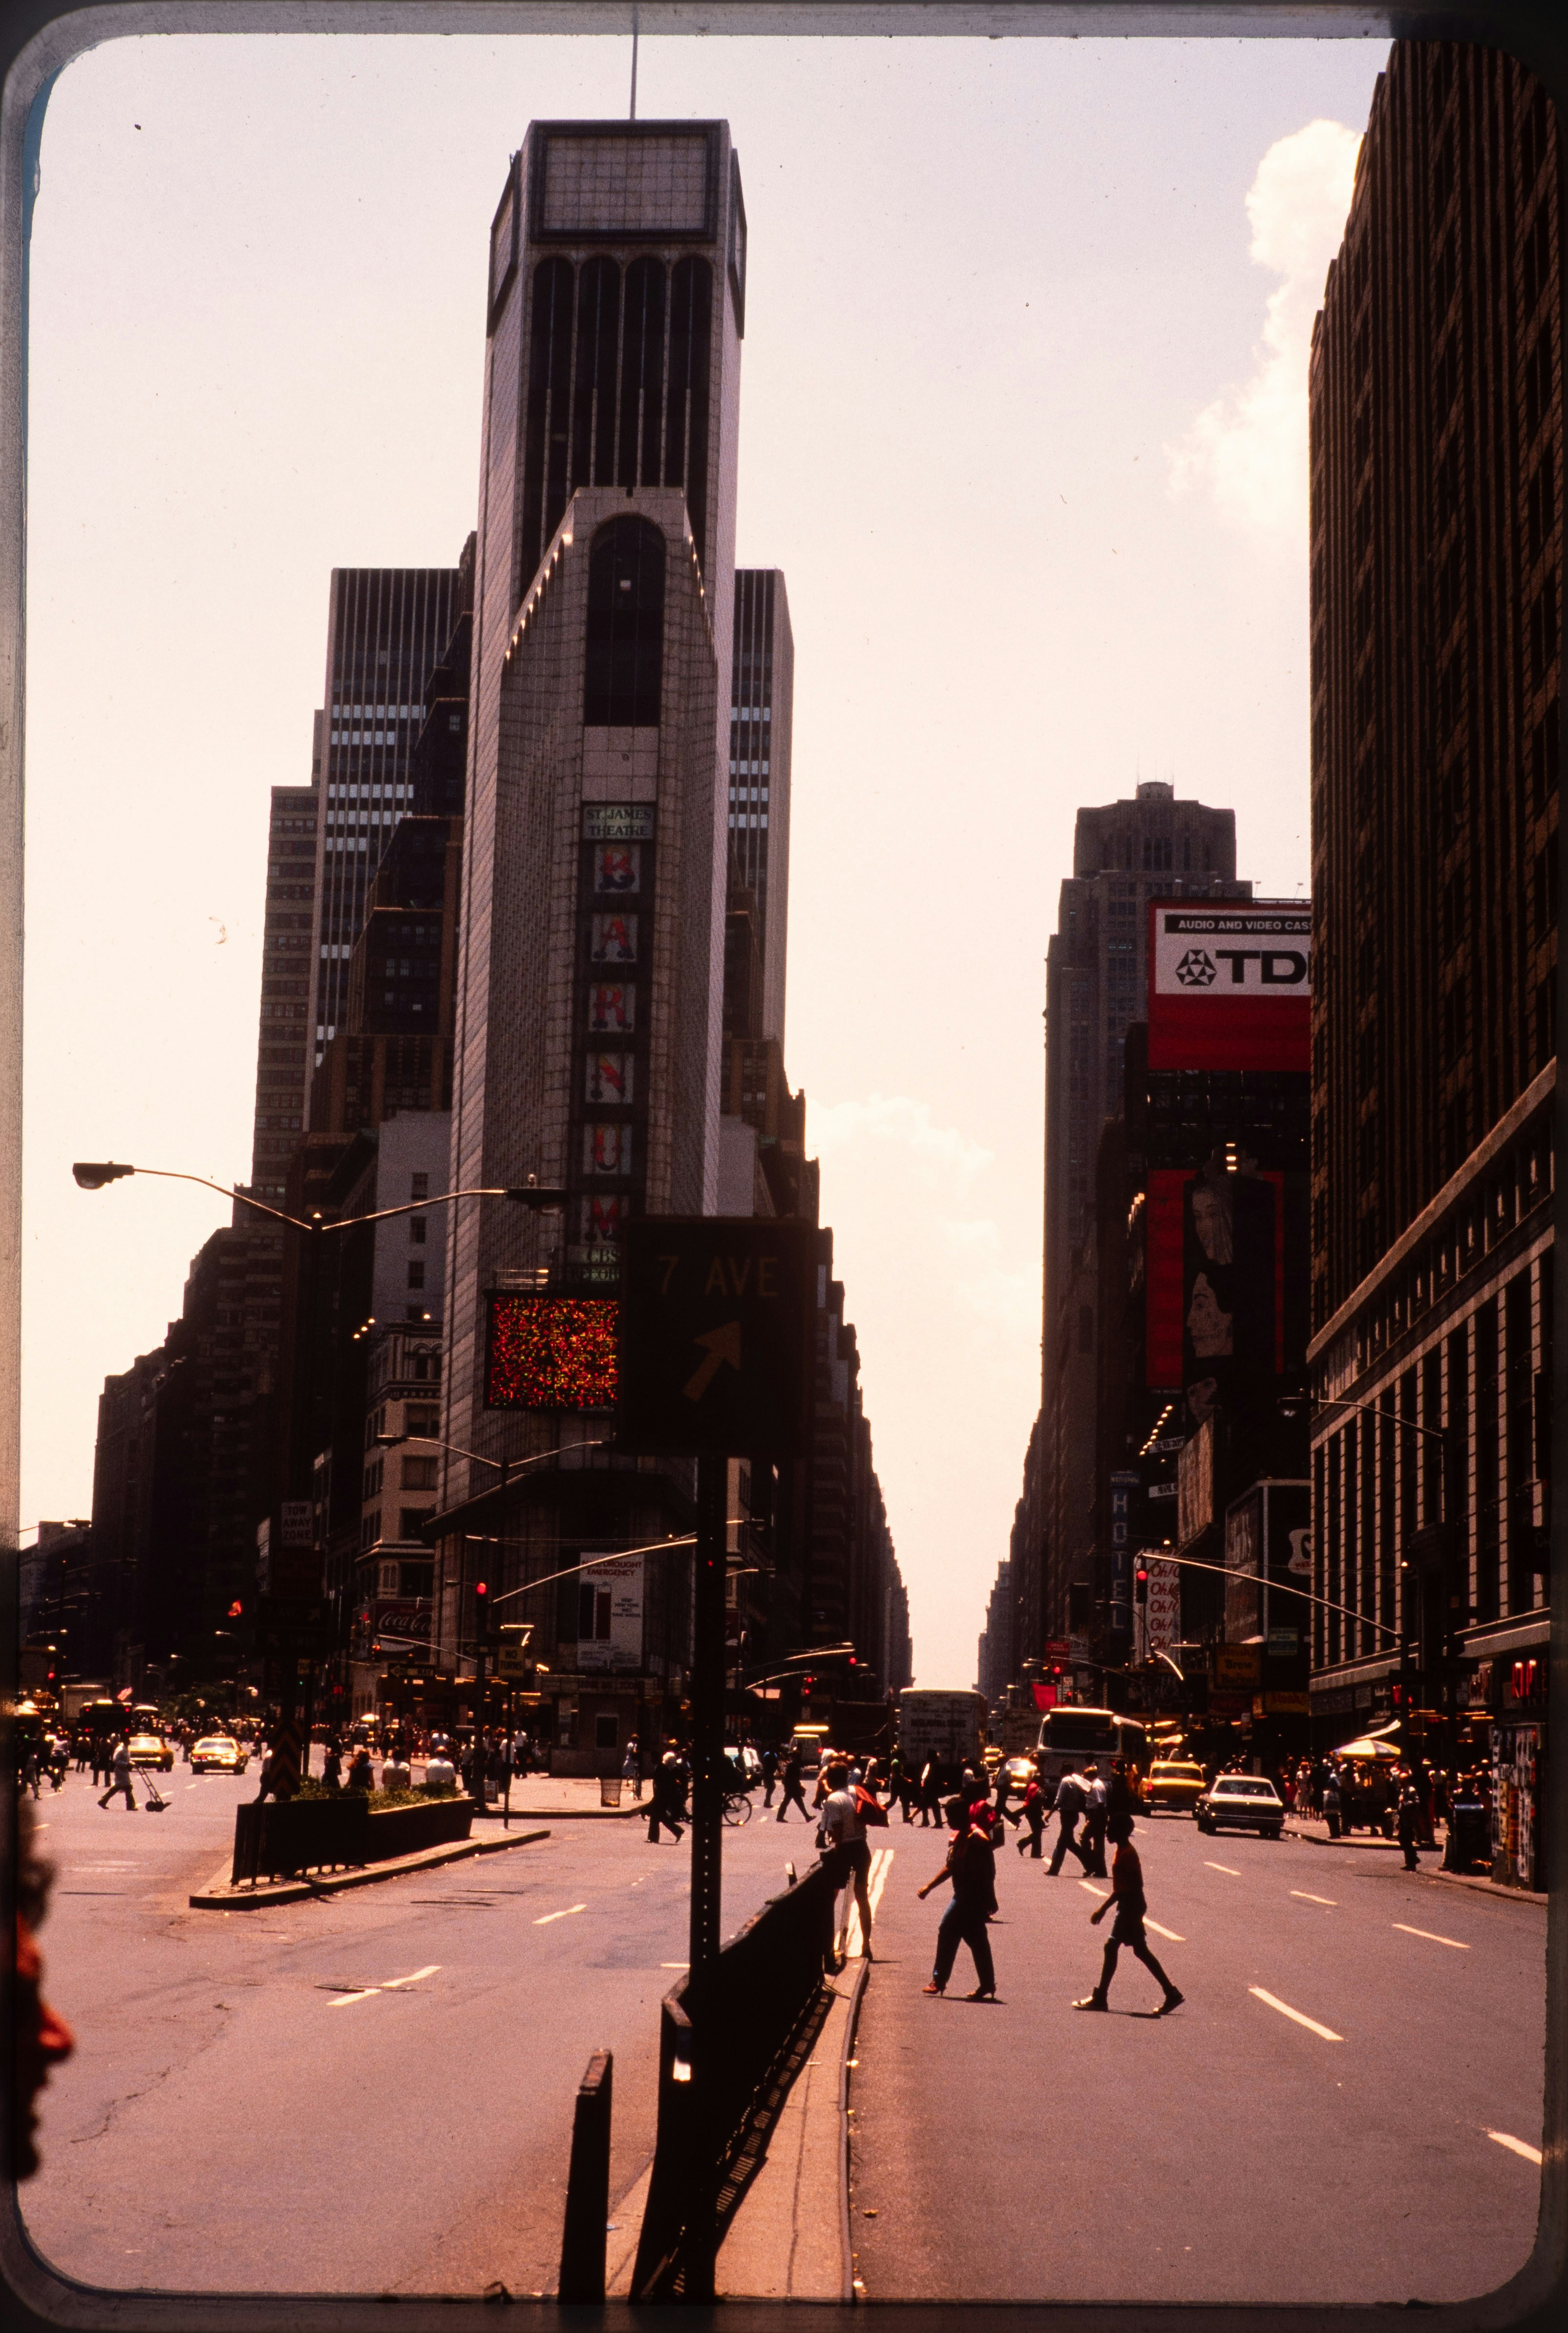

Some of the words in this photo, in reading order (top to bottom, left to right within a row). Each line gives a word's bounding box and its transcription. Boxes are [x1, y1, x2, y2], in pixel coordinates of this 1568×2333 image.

[587, 809, 604, 820] ST.
[608, 808, 651, 820] JAMES
[588, 825, 648, 836] THEATRE
[1178, 920, 1215, 929] AUDIO
[1218, 921, 1242, 930] AND
[1246, 921, 1281, 930] VIDEO
[1285, 922, 1312, 931] CAS
[1216, 950, 1311, 984] TD
[588, 1248, 619, 1264] CBS
[657, 1255, 680, 1295] 7
[704, 1257, 779, 1297] AVE
[287, 1506, 307, 1515] TOW
[283, 1518, 311, 1527] AWAY
[283, 1530, 311, 1540] ZONE
[1112, 1493, 1128, 1629] HOTEL
[506, 1650, 517, 1659] NO
[500, 1661, 522, 1670] TURNS
[1225, 1659, 1252, 1669] Brew
